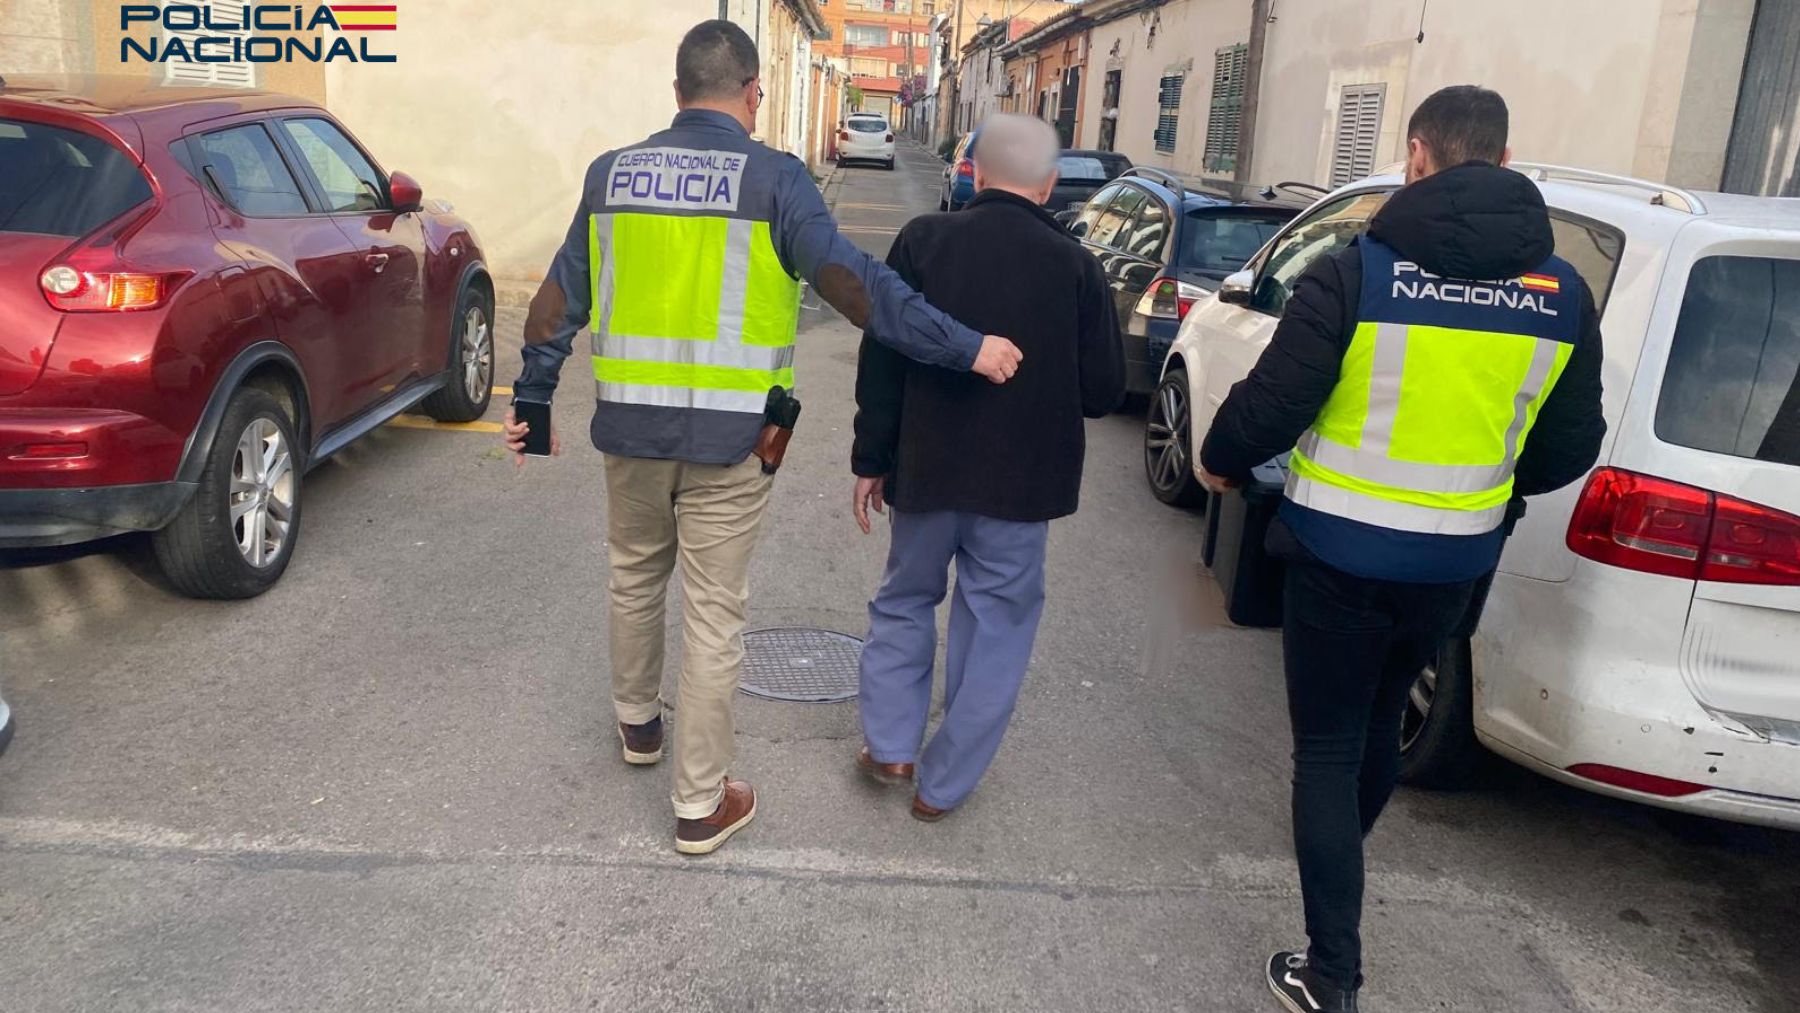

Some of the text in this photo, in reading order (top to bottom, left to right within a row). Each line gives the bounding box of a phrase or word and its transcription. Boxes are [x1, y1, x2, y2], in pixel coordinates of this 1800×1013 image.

[618, 152, 740, 171] CUERPO NACIONAL DE
[611, 171, 731, 202] POLICIA
[1392, 280, 1558, 316] NACIONAL
